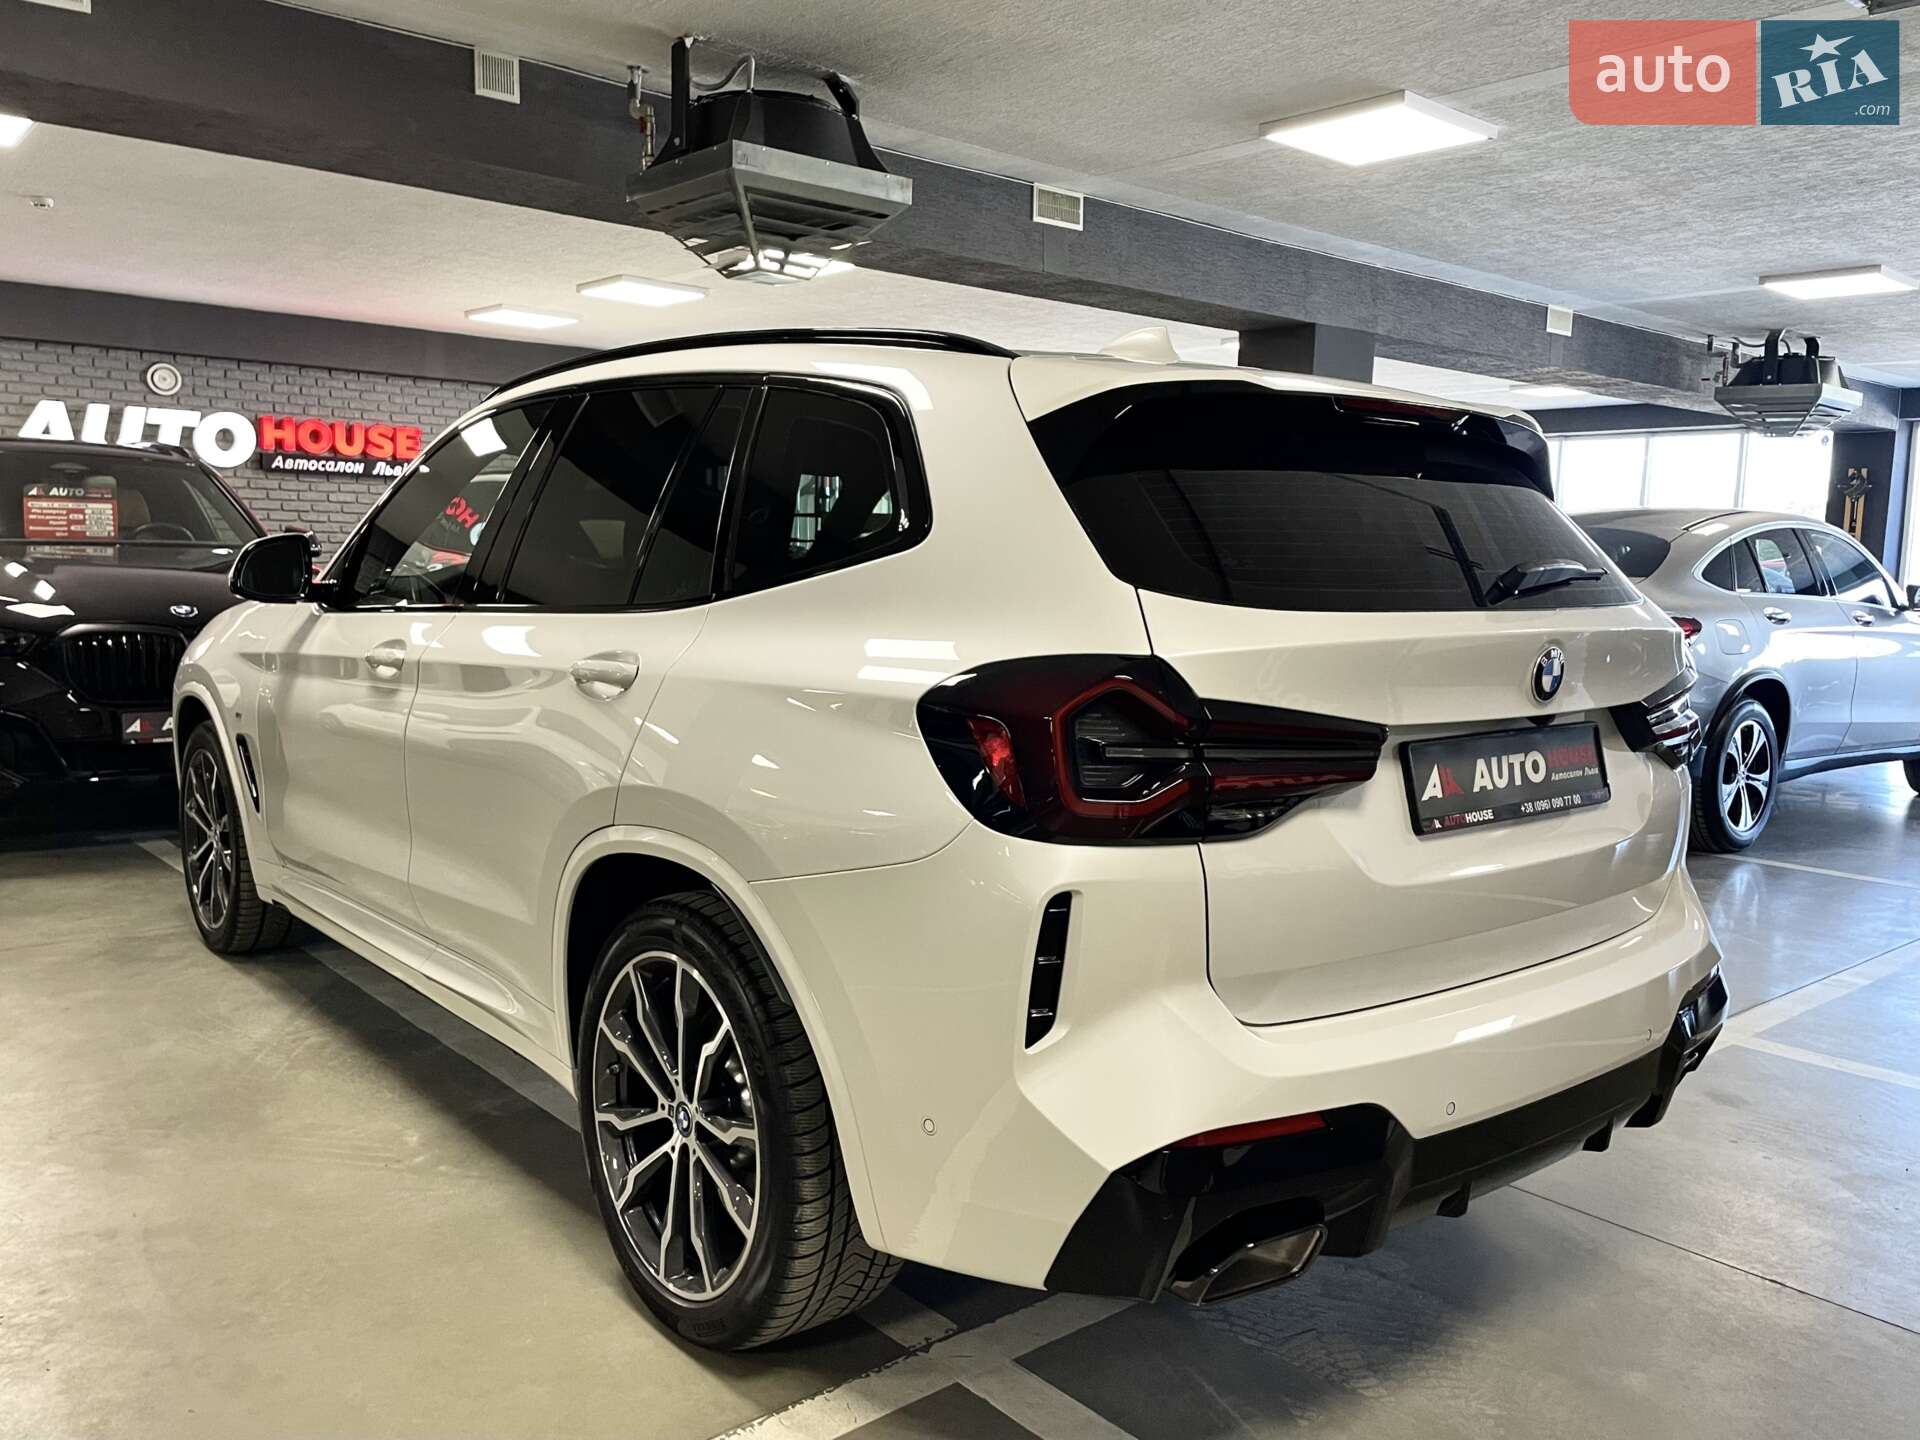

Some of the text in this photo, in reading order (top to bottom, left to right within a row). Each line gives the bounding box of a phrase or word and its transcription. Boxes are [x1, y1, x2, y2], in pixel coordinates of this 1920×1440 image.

[17, 399, 422, 468] AUTO HOUSE
[271, 455, 365, 474] Автосалон
[49, 487, 85, 497] AUTO
[1473, 750, 1547, 793] AUTO
[1520, 802, 1534, 813] +38
